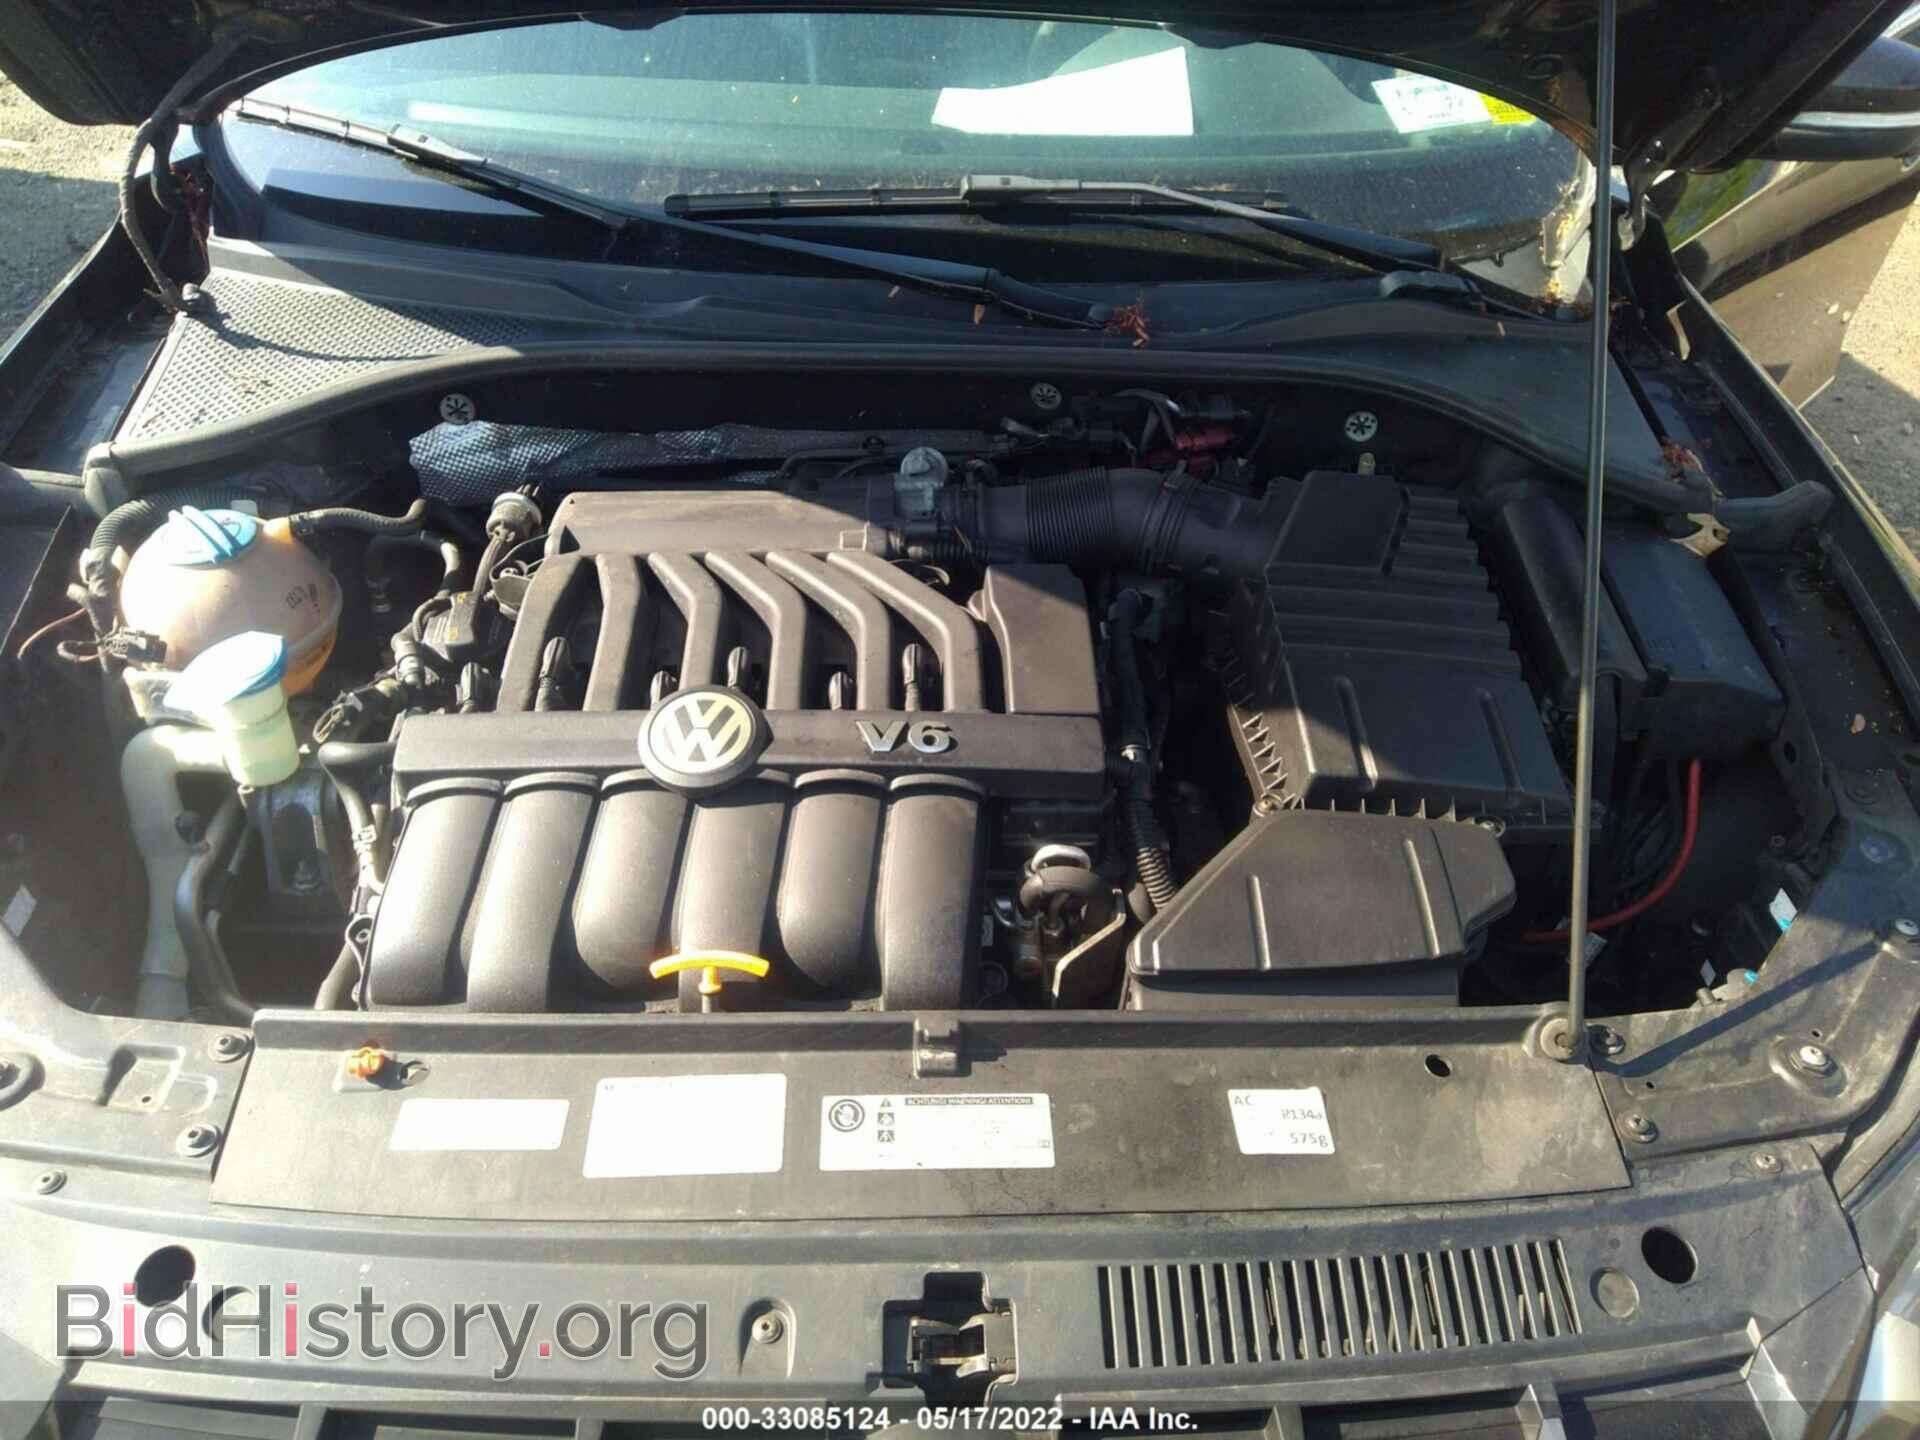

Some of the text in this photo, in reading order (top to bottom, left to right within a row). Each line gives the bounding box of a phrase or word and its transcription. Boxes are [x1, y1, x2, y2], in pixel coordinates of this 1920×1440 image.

[855, 720, 954, 753] V6
[1233, 1095, 1253, 1105] AC
[1289, 1132, 1329, 1149] 575g
